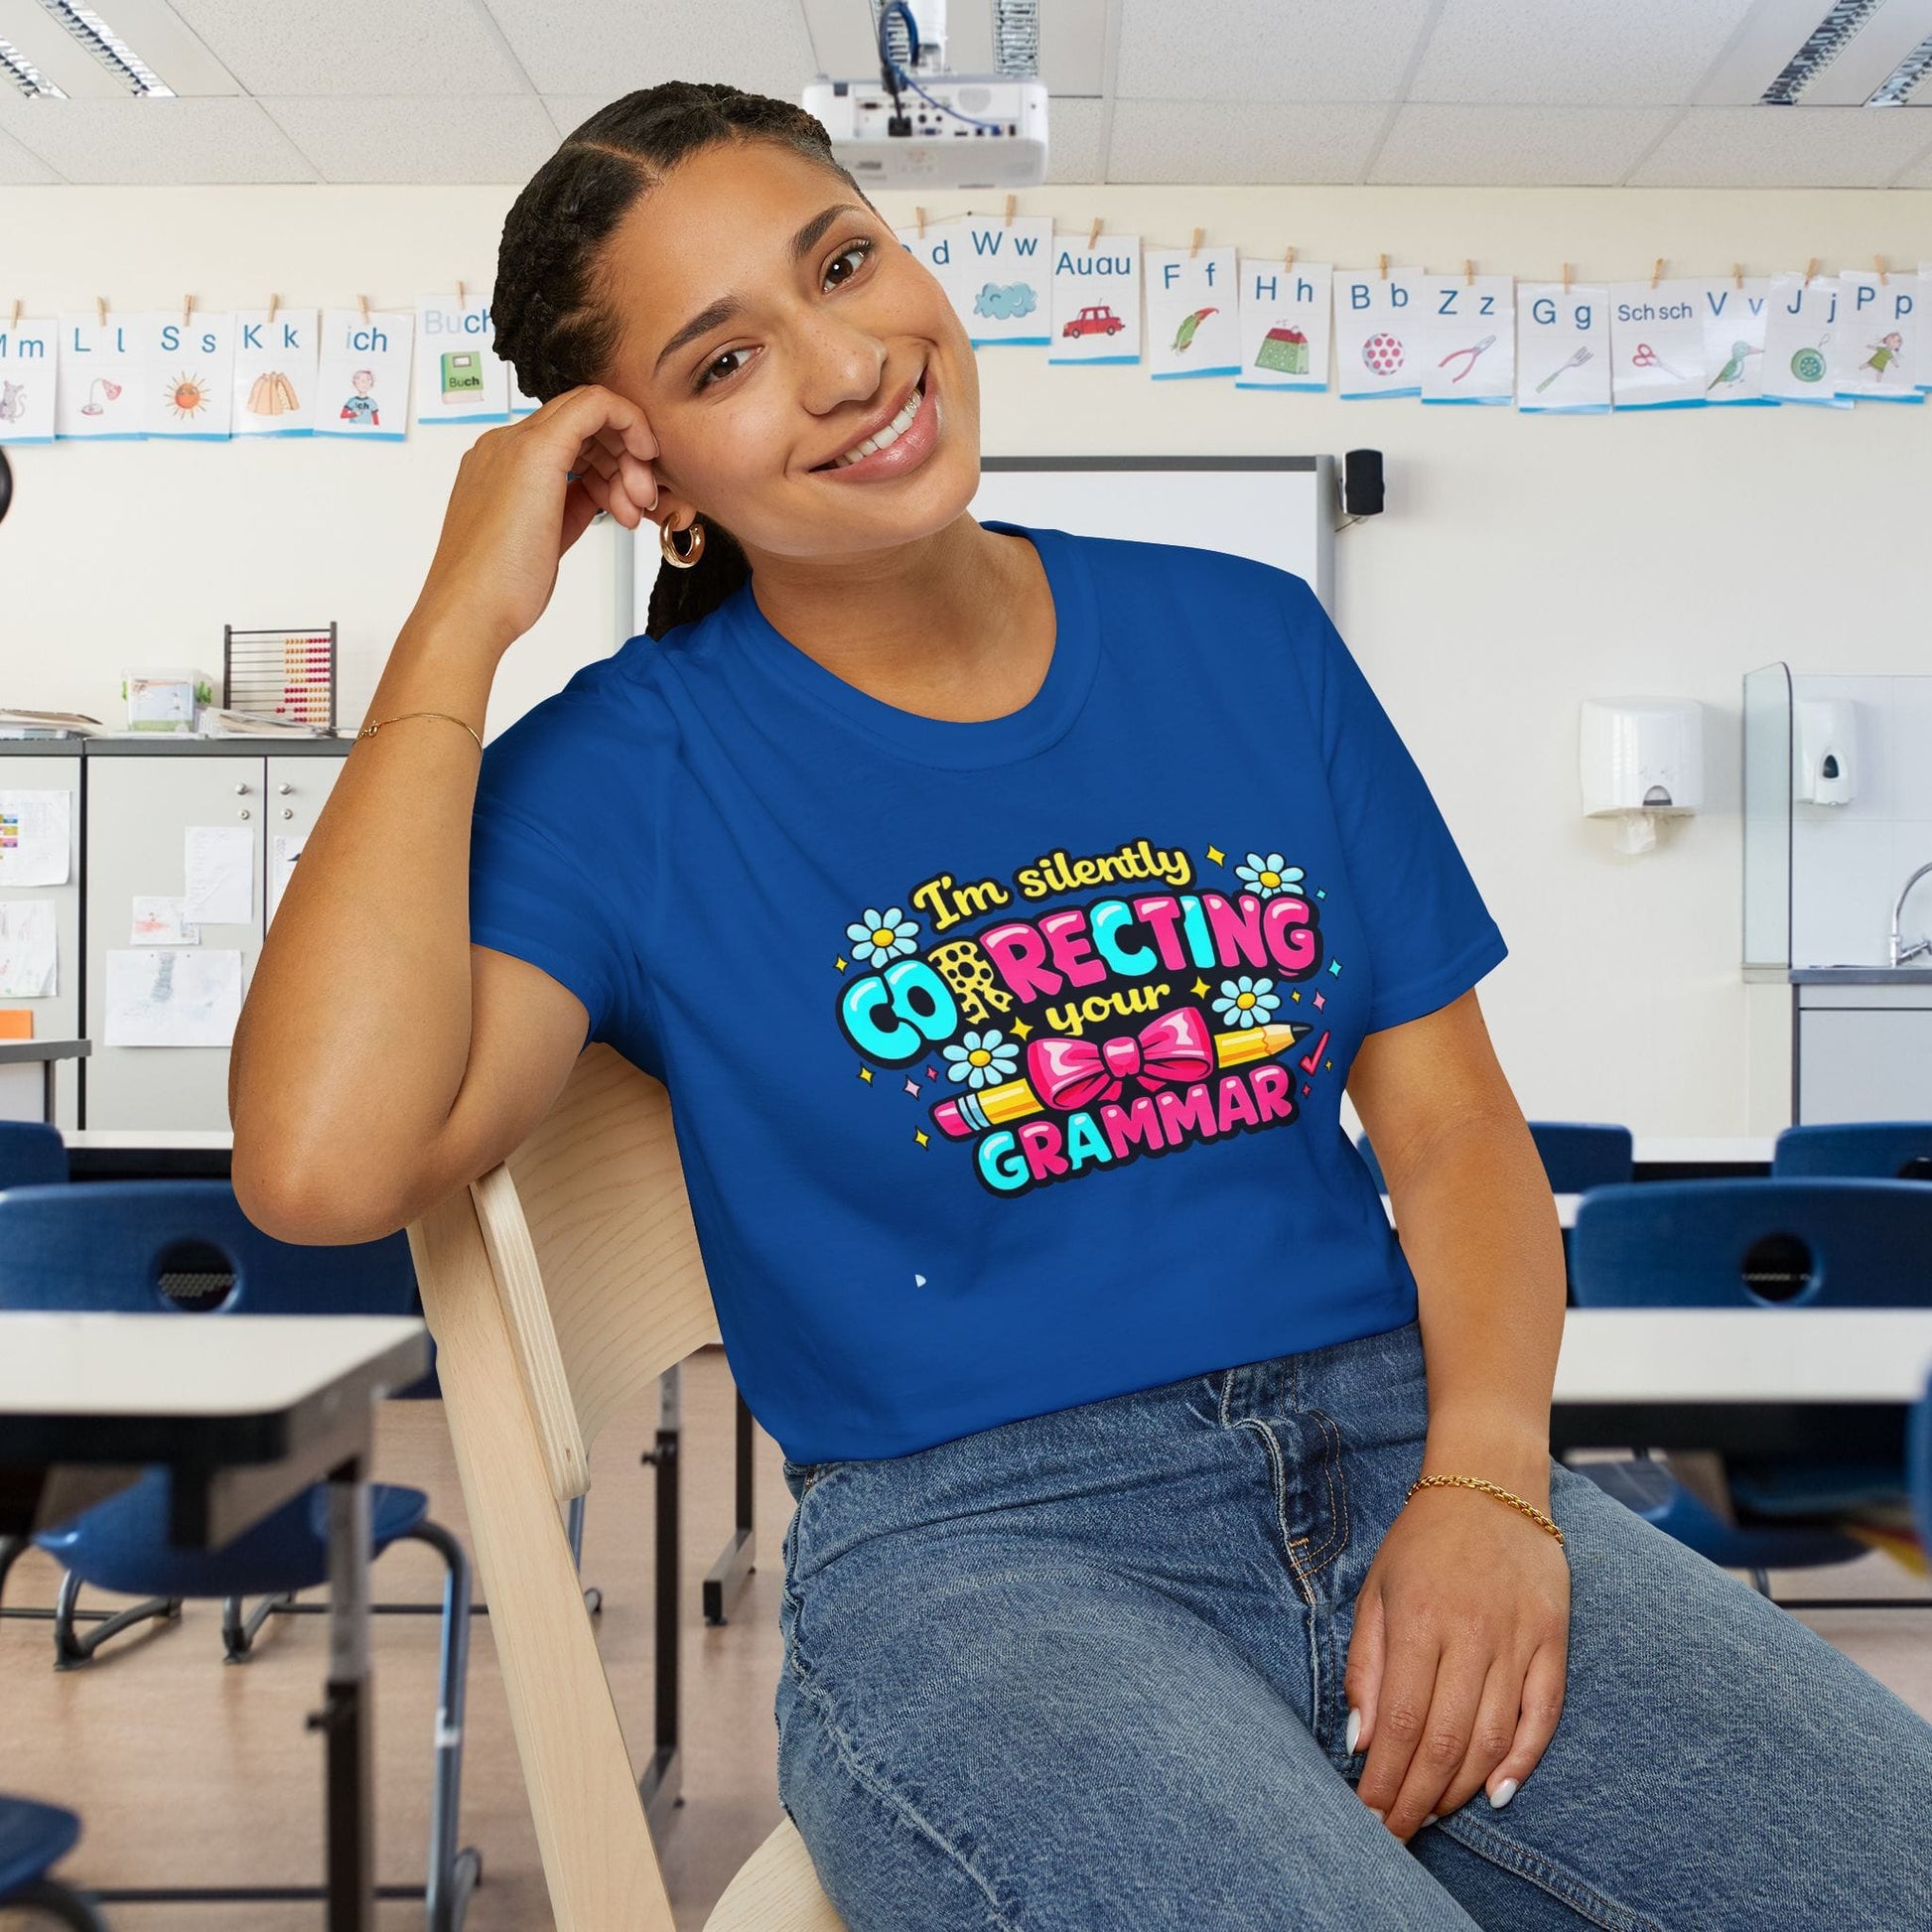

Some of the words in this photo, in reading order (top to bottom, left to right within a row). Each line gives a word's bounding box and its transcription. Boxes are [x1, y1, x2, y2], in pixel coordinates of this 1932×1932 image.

[972, 230, 1002, 255] W
[1015, 238, 1037, 255] w
[1056, 252, 1130, 275] Auau
[1165, 264, 1179, 289] F
[1206, 263, 1215, 286] f
[1256, 276, 1276, 300] H
[1298, 278, 1312, 302] h
[1352, 285, 1370, 309] B
[1391, 283, 1408, 307] b
[1439, 291, 1457, 314] Z
[1480, 297, 1494, 315] z
[1533, 299, 1555, 324] G
[1576, 306, 1590, 330] g
[1618, 304, 1654, 322] Sch
[1660, 303, 1692, 320] sch
[1708, 292, 1727, 316] V
[1748, 299, 1763, 315] v
[1787, 290, 1801, 314] J
[1828, 294, 1836, 323] j
[1858, 287, 1874, 310] P
[1896, 296, 1912, 319] p
[75, 328, 90, 351] L
[118, 328, 124, 352] l
[162, 327, 179, 350] S
[202, 335, 215, 352] s
[244, 325, 262, 348] K
[285, 325, 298, 347] k
[346, 326, 388, 352] ich
[449, 376, 481, 388] Buch
[913, 876, 1008, 930] I'm
[1019, 841, 1190, 897] silently
[842, 895, 1315, 1059] CORRECTING
[1045, 983, 1170, 1035] your
[978, 1064, 1293, 1191] GRAMMAR
